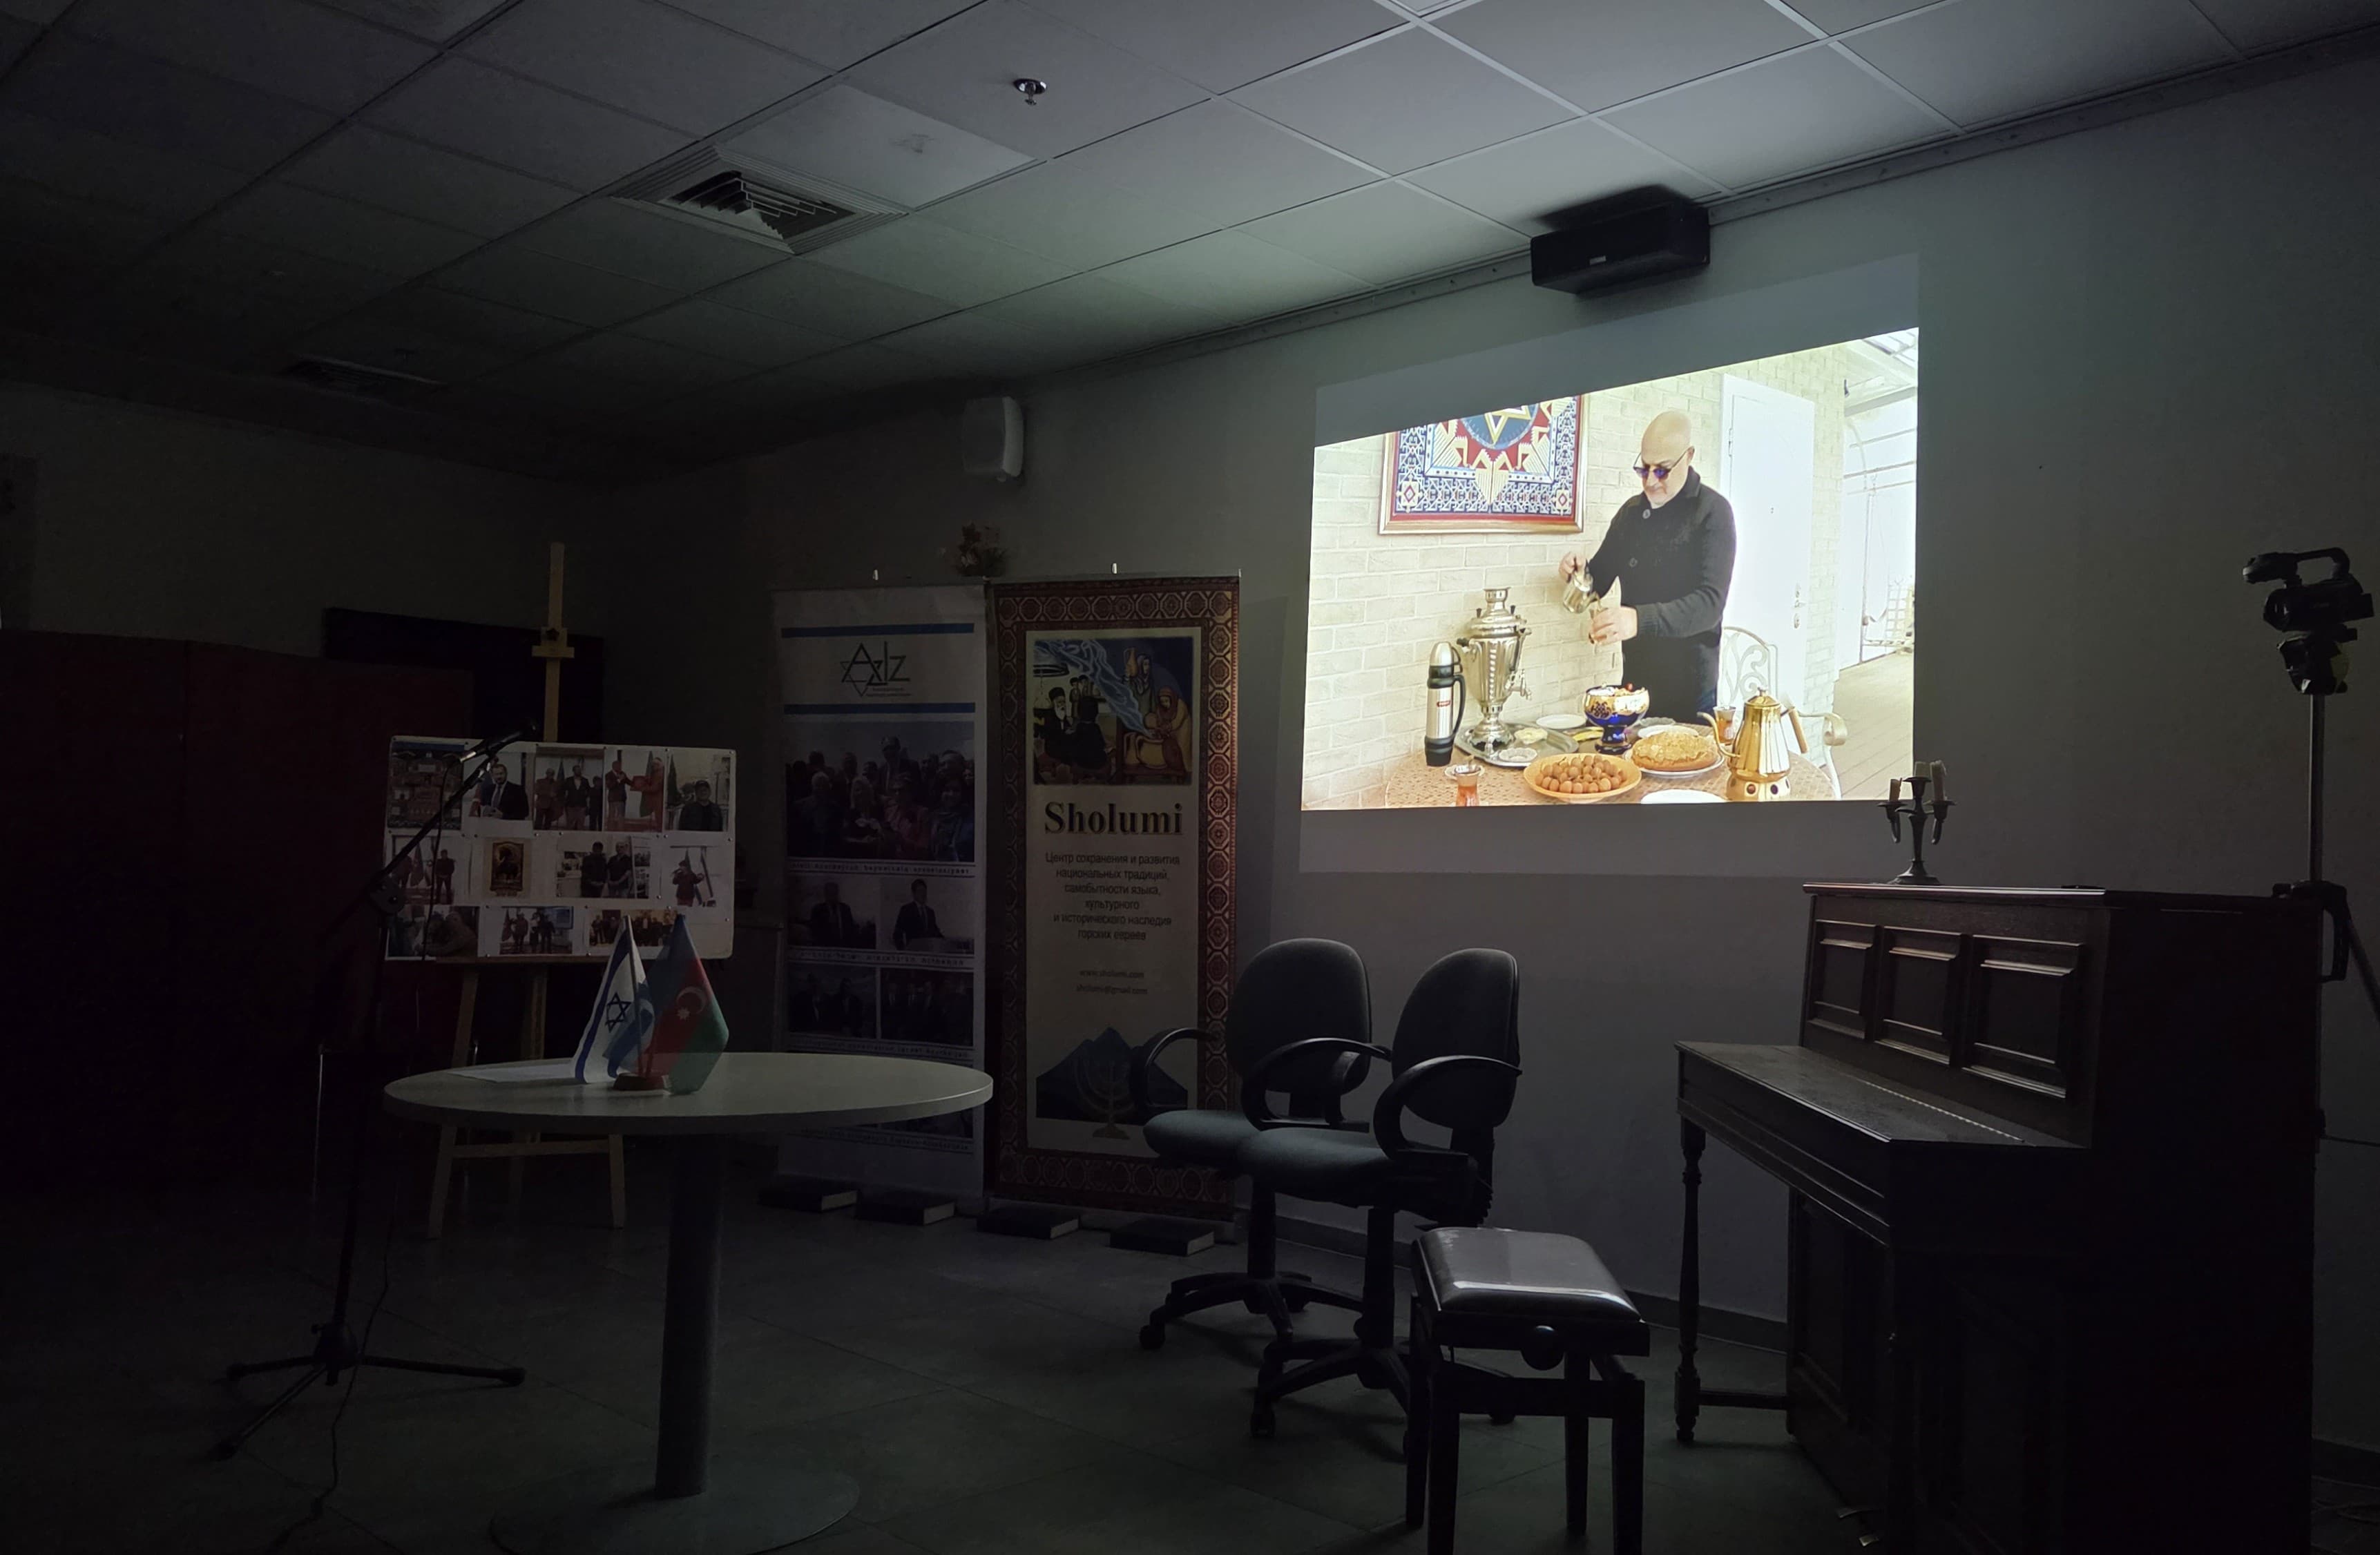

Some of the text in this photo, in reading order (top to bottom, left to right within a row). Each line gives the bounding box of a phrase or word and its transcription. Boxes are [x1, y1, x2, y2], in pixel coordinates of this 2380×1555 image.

[1045, 802, 1182, 833] Sholumi
[1046, 852, 1073, 864] Центр
[1076, 854, 1128, 864] сохранения
[1139, 856, 1180, 865] развития
[1056, 869, 1121, 879] национальных
[1064, 882, 1129, 894] самобытности
[1085, 900, 1140, 911] культурного
[1053, 914, 1171, 927] и исторического наследия
